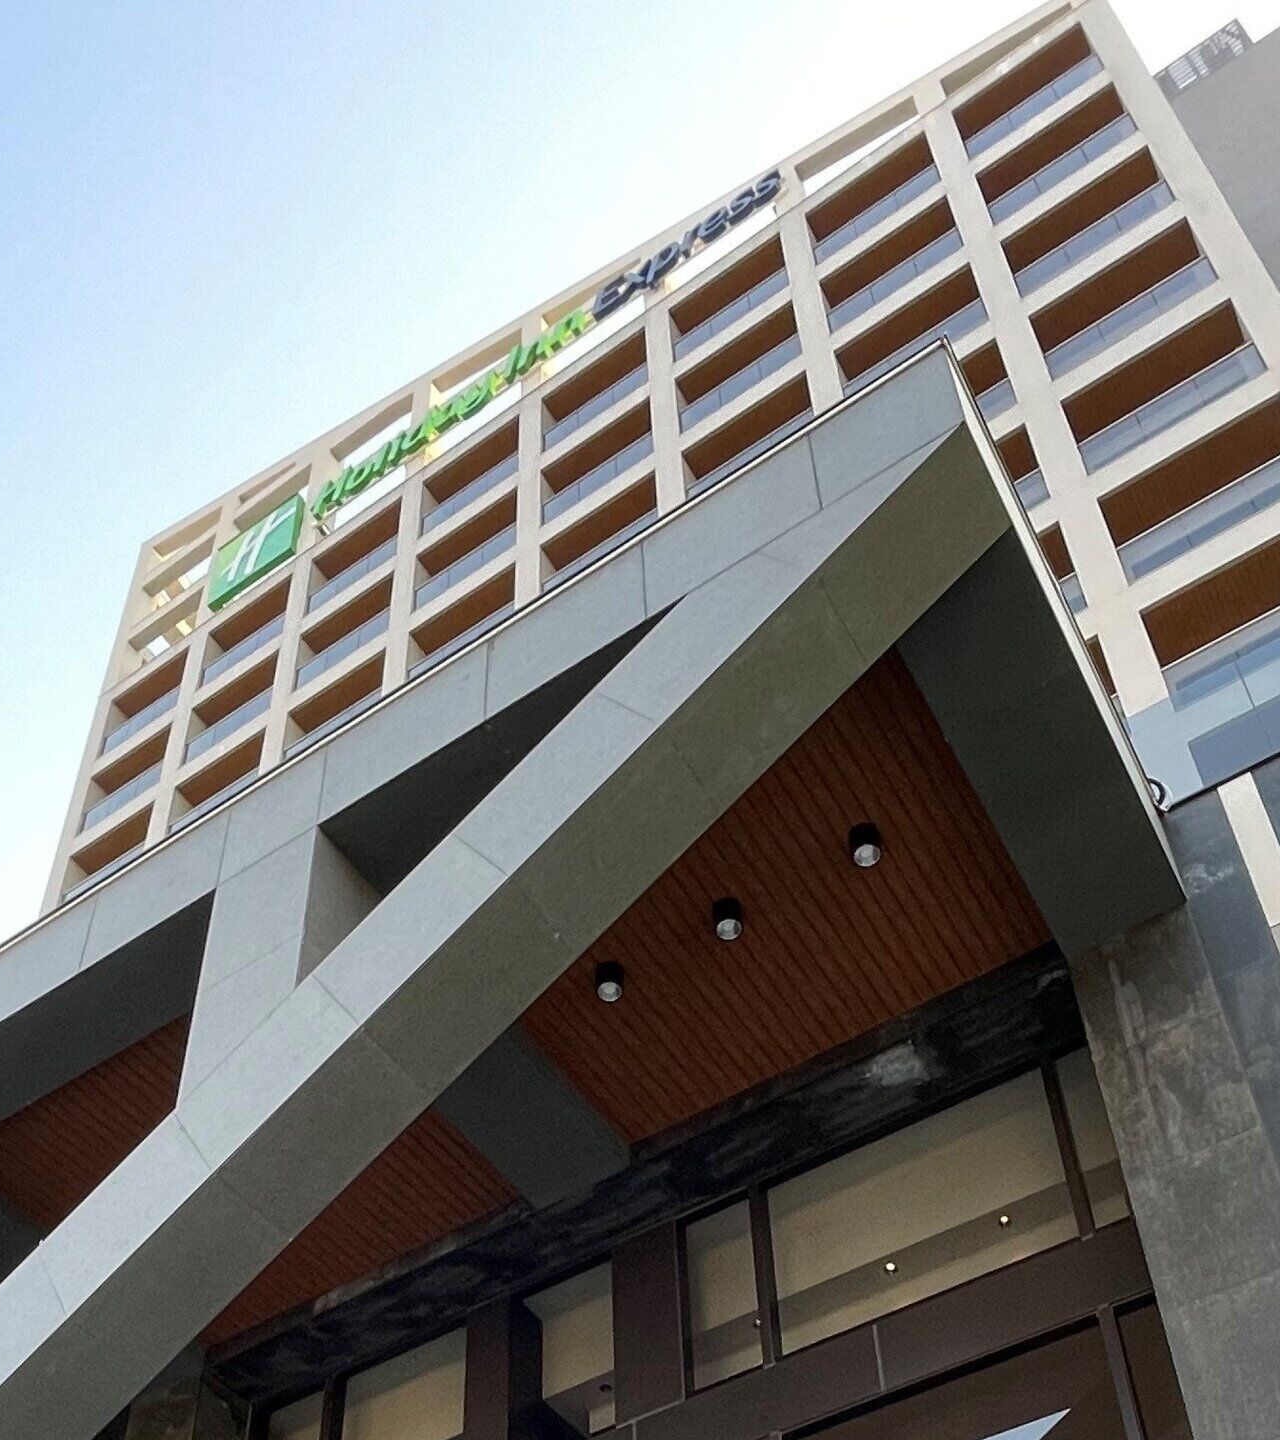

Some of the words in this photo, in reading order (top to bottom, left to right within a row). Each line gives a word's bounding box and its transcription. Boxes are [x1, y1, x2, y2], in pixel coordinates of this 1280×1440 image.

[592, 168, 782, 322] Express
[311, 370, 503, 521] Holiday
[504, 308, 587, 385] Inn
